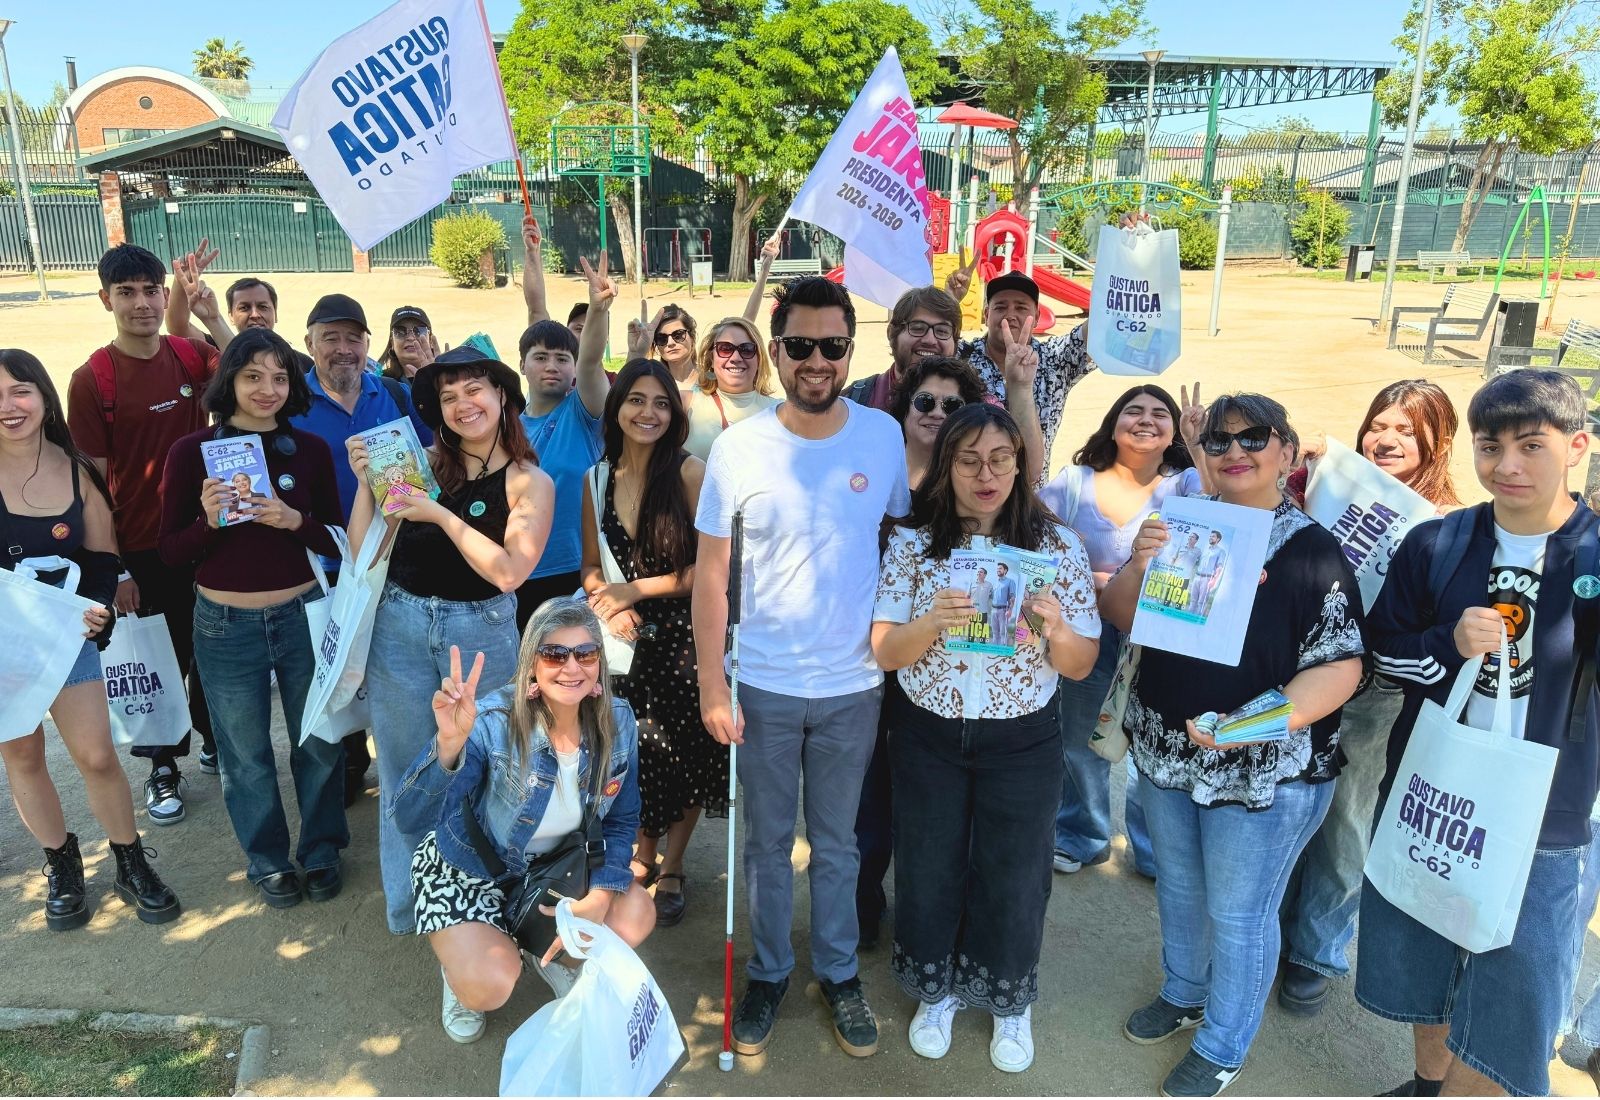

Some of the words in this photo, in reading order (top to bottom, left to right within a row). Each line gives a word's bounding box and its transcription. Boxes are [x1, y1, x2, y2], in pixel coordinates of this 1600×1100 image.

[842, 157, 921, 224] PRESIDENTA
[836, 183, 867, 210] 2026
[871, 203, 904, 231] 2030
[1109, 274, 1149, 293] GUSTAVO
[1106, 288, 1162, 313] GATICA
[1105, 309, 1162, 319] DIPUTADO
[1116, 320, 1147, 333] C-62
[207, 447, 229, 457] C-62
[214, 456, 258, 473] JARA
[1342, 501, 1401, 572] ATICA
[953, 562, 978, 570] C-62
[1149, 569, 1185, 588] GUSTAVO
[1145, 579, 1190, 606] GATICA
[1487, 569, 1541, 603] COOL
[125, 702, 154, 716] C-62
[1408, 773, 1476, 821] GUSTAVO
[1399, 792, 1487, 861] GATICA
[1396, 821, 1480, 870] DIPUTADO
[1408, 844, 1452, 881] C-62
